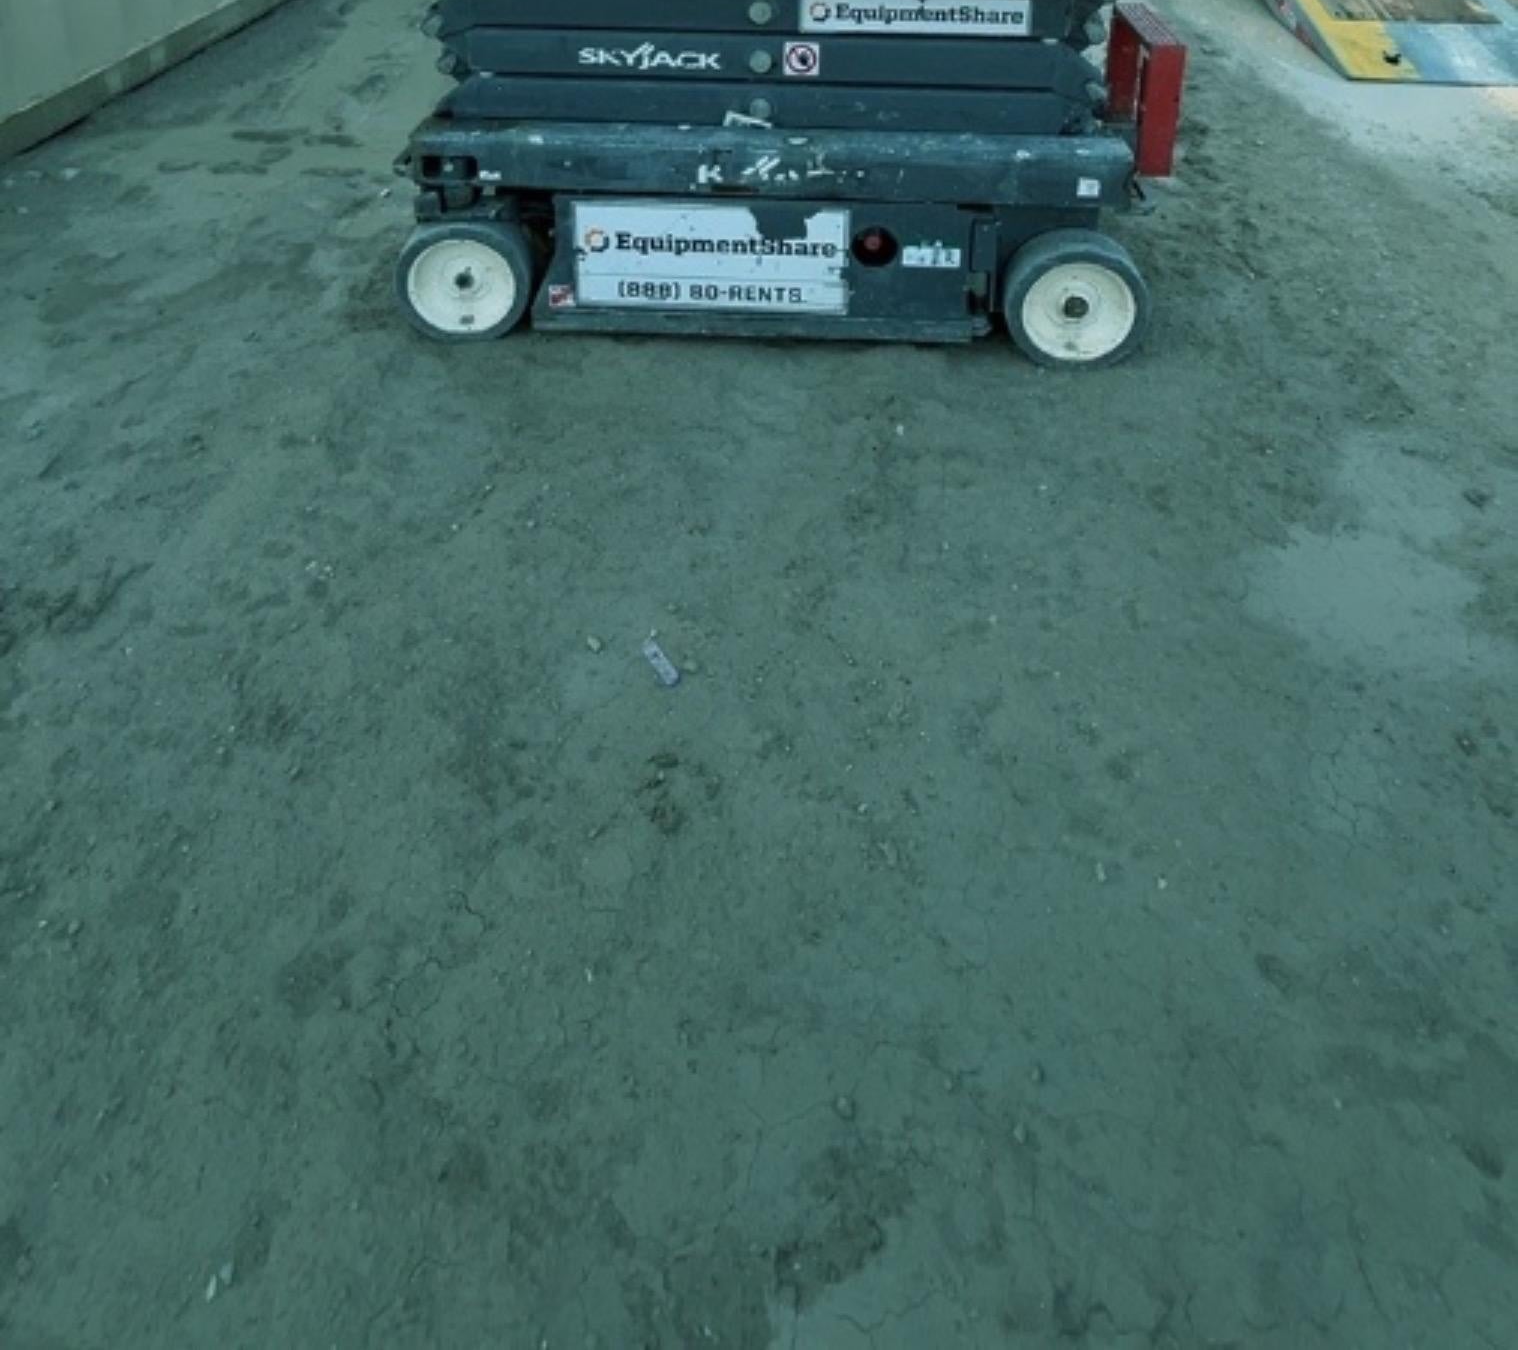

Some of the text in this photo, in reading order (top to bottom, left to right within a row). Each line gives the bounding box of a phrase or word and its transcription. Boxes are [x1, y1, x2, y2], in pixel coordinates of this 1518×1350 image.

[834, 2, 1025, 25] EquipmentShare
[578, 41, 722, 70] SKYJACK
[614, 232, 838, 258] EquipmentShare
[618, 280, 804, 303] (888) 80-RENTS
